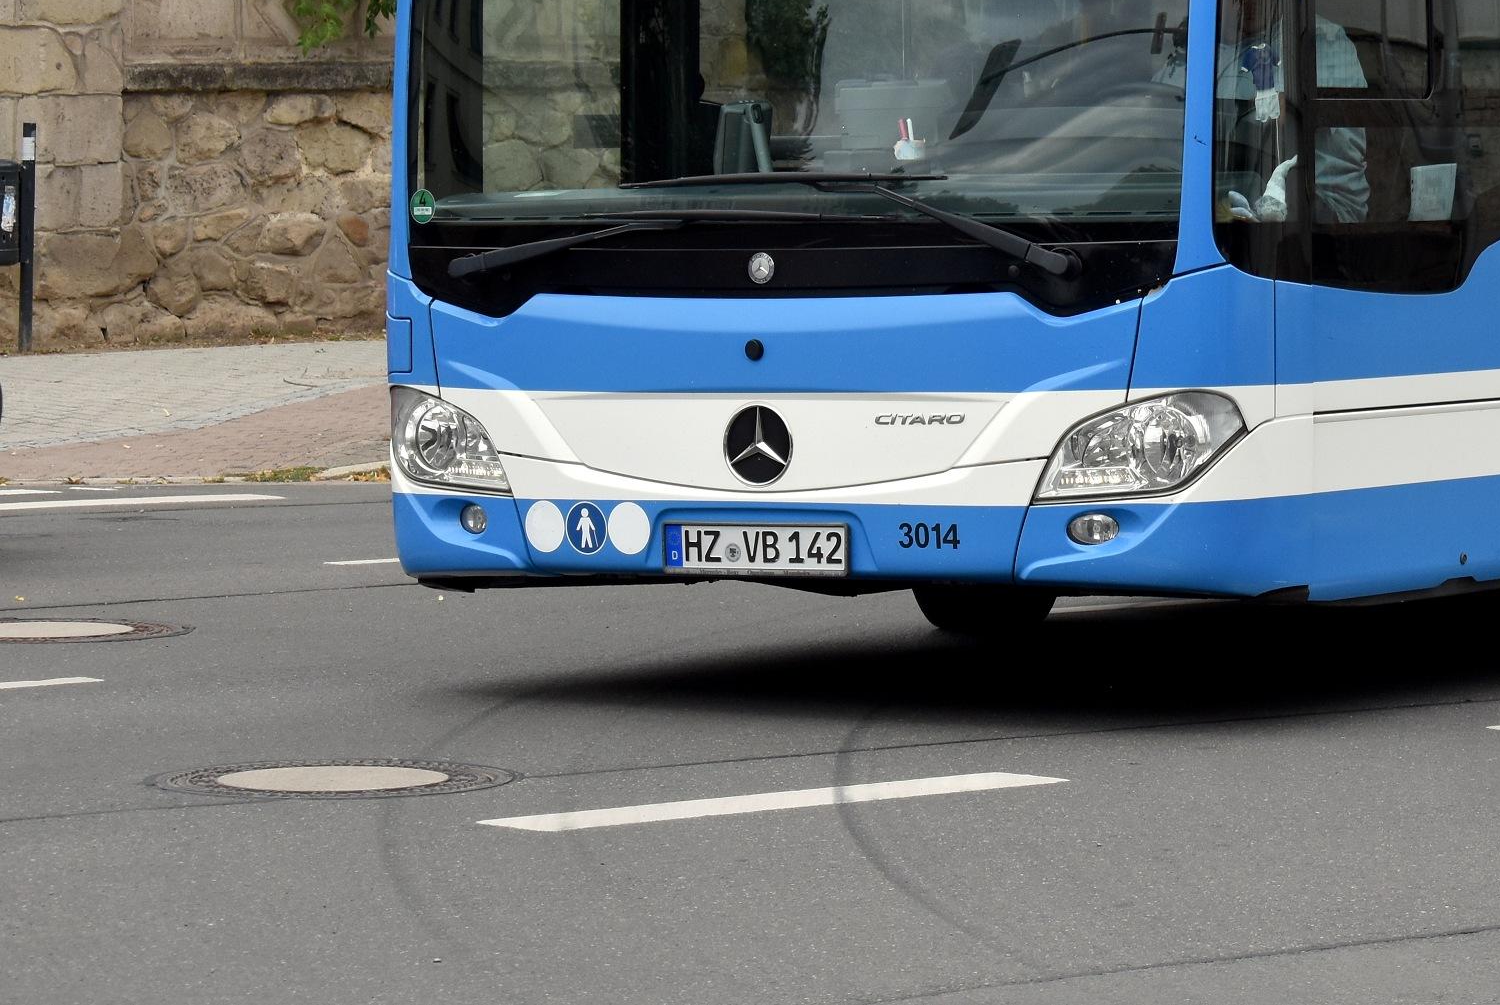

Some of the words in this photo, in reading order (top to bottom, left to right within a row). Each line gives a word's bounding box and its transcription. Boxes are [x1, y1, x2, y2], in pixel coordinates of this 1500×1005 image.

[419, 192, 426, 206] 4
[875, 413, 965, 425] CITARO
[899, 522, 960, 549] 3014
[684, 530, 722, 563] HZ
[742, 531, 781, 563] VB
[788, 531, 843, 564] 142
[672, 551, 678, 560] D
